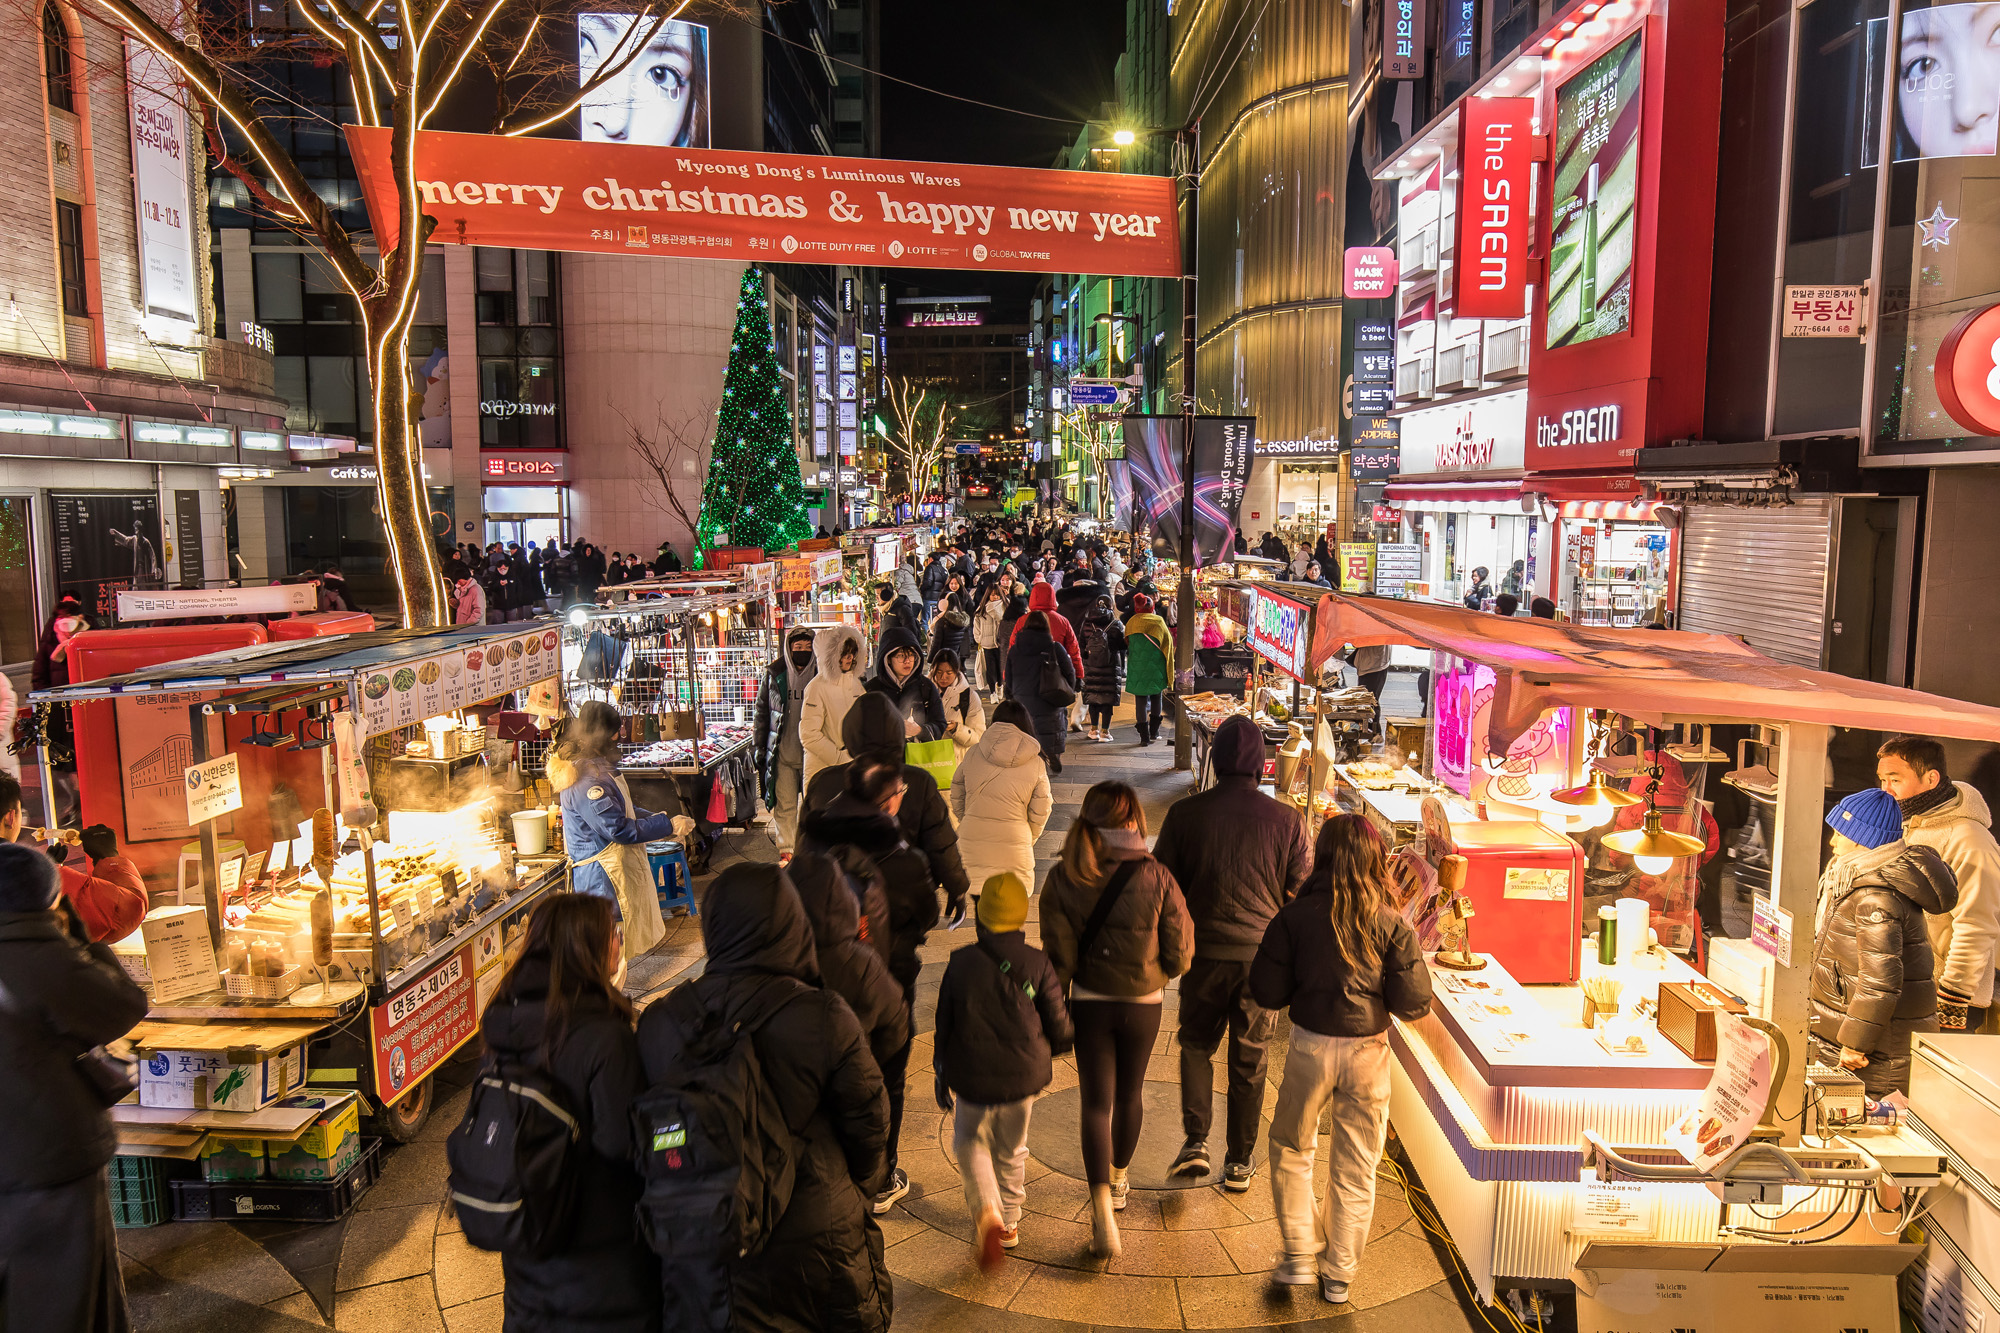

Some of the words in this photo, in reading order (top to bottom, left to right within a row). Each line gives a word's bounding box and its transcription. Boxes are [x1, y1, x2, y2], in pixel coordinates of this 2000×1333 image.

[1577, 98, 1596, 128] 하루
[1598, 82, 1618, 118] 종일
[1582, 118, 1610, 154] 촉촉촉
[676, 158, 750, 179] Myeong
[756, 162, 816, 181] Dong's
[821, 166, 906, 184] Luminous
[910, 172, 961, 187] Waves
[416, 180, 564, 214] merry
[582, 178, 808, 219] christmas
[828, 190, 864, 224] &
[877, 191, 996, 236] happy
[1007, 206, 1080, 232] new
[1089, 211, 1161, 242] year
[590, 228, 614, 242] 주최
[748, 237, 770, 249] 후원
[799, 241, 827, 252] LOTTE
[829, 242, 854, 252] DUTY
[854, 243, 876, 253] FREE
[906, 246, 938, 255] LOTTE
[1360, 254, 1379, 265] ALL
[1354, 268, 1384, 278] MASK
[1353, 280, 1384, 291] STORY
[1792, 290, 1814, 298] 한일관
[1817, 290, 1857, 298] 공인중개사
[1791, 300, 1854, 322] 부동산
[1838, 325, 1850, 333] 6층
[1372, 418, 1388, 428] WE
[1537, 415, 1560, 448] the
[1560, 404, 1621, 446] SAEM
[1267, 434, 1340, 453] essenherb
[331, 466, 358, 478] Café
[508, 461, 555, 474] 다이소
[1568, 534, 1580, 546] SALE
[1581, 535, 1594, 548] SALE
[1346, 556, 1369, 580] 足
[134, 600, 175, 610] 국립극단
[544, 636, 556, 648] Mix
[135, 691, 202, 706] 명동예술극장
[366, 706, 390, 718] Vegetable
[202, 760, 236, 783] 신한은행
[932, 760, 954, 768] YOUNG
[479, 958, 498, 974] KOREA
[392, 960, 459, 1021] 명동수제어묵
[380, 1013, 420, 1052] Myeongdong
[420, 994, 448, 1022] handmade
[449, 984, 458, 1004] fish
[458, 977, 470, 996] cake
[178, 1055, 222, 1074] 풋고추
